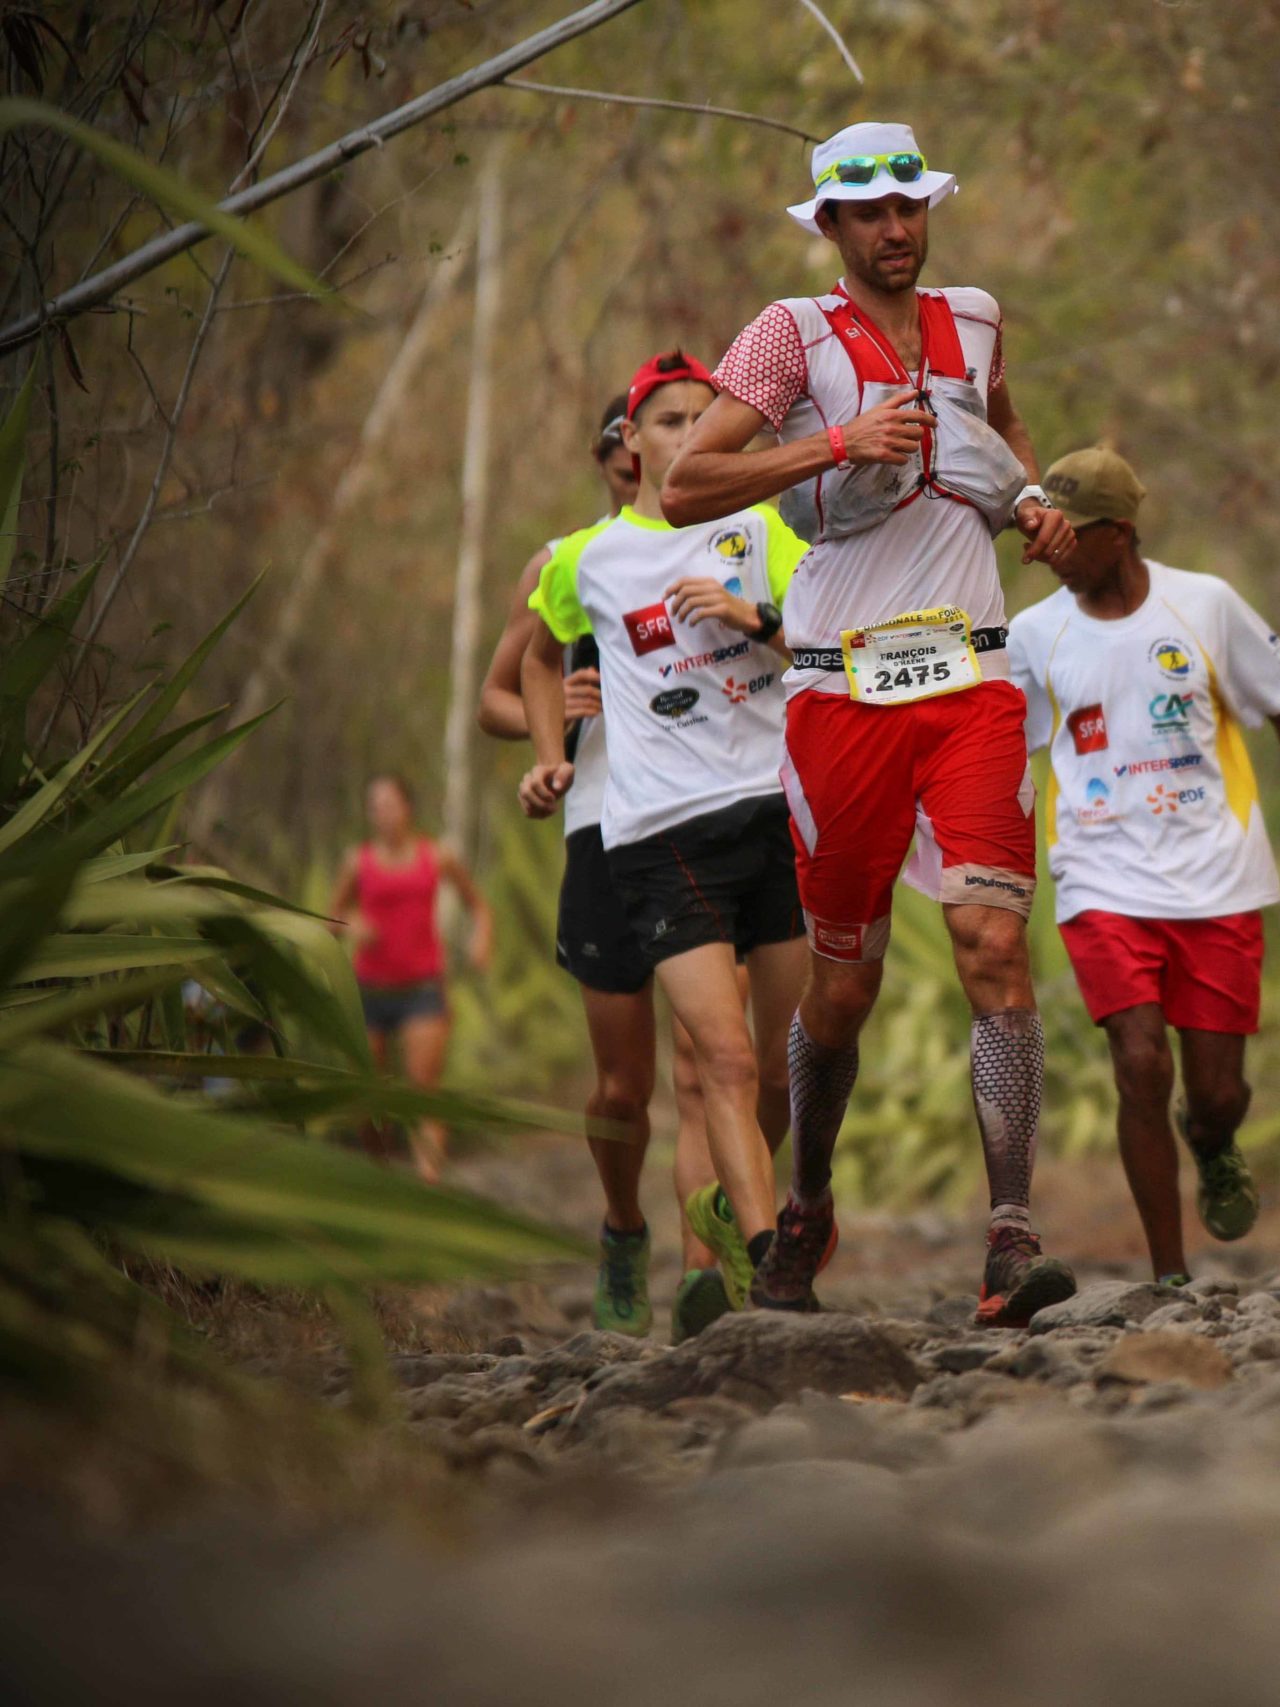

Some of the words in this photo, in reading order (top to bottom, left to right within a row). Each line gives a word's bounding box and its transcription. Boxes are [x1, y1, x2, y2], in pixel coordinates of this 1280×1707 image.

[938, 606, 962, 619] FOUS
[637, 616, 670, 640] SFR
[673, 641, 750, 674] INTERSPORT
[880, 646, 937, 661] FRANÇOIS
[874, 661, 951, 692] 2475
[1079, 716, 1105, 739] SFR
[1128, 755, 1202, 775] INTERSPORT
